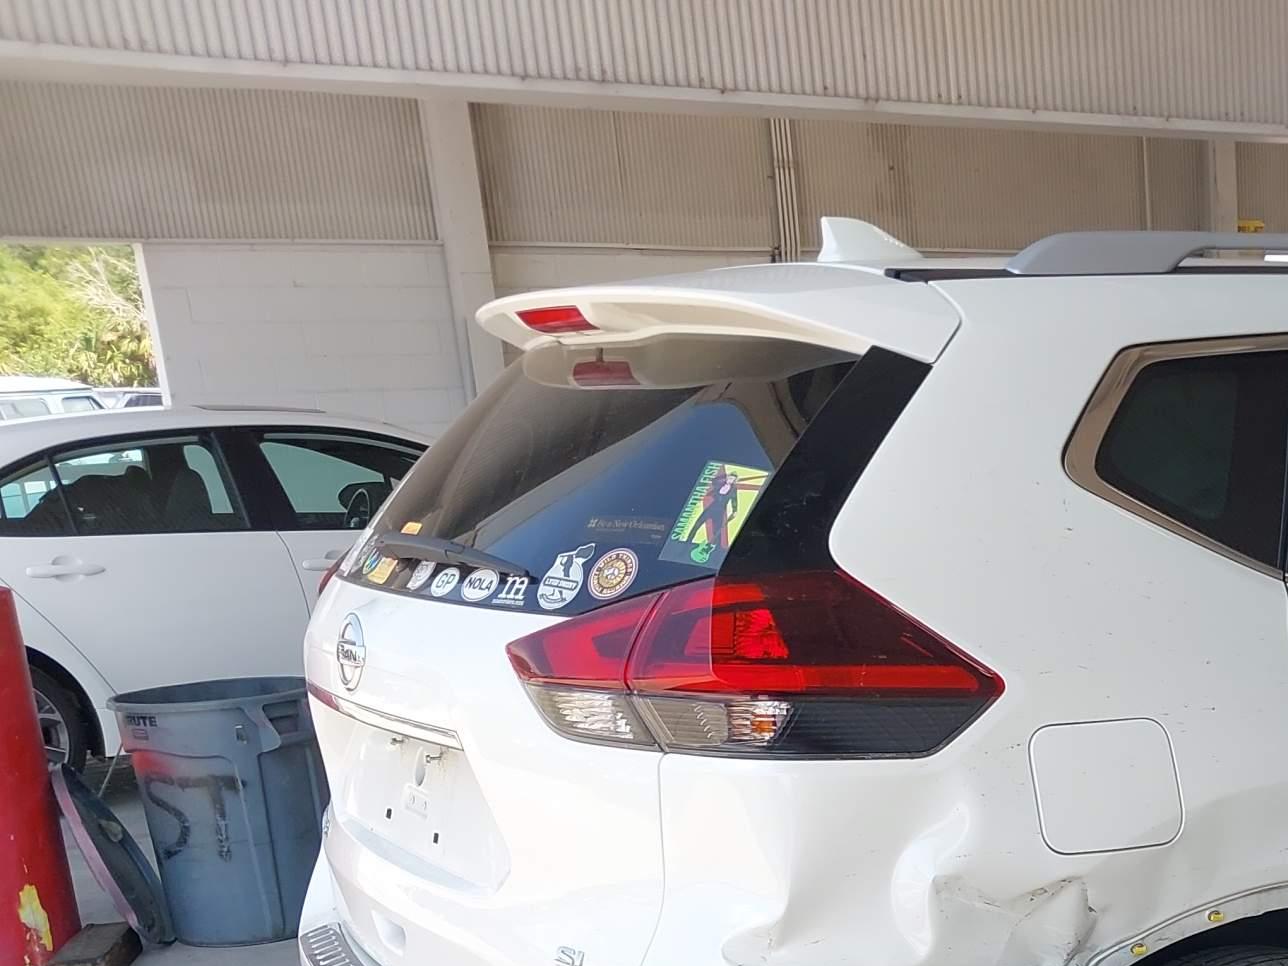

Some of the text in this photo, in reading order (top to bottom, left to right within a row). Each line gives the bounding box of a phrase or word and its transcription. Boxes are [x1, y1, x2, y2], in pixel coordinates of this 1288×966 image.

[671, 462, 723, 540] SAMANTHA FISH
[436, 572, 456, 589] GP
[466, 576, 493, 592] NOLA
